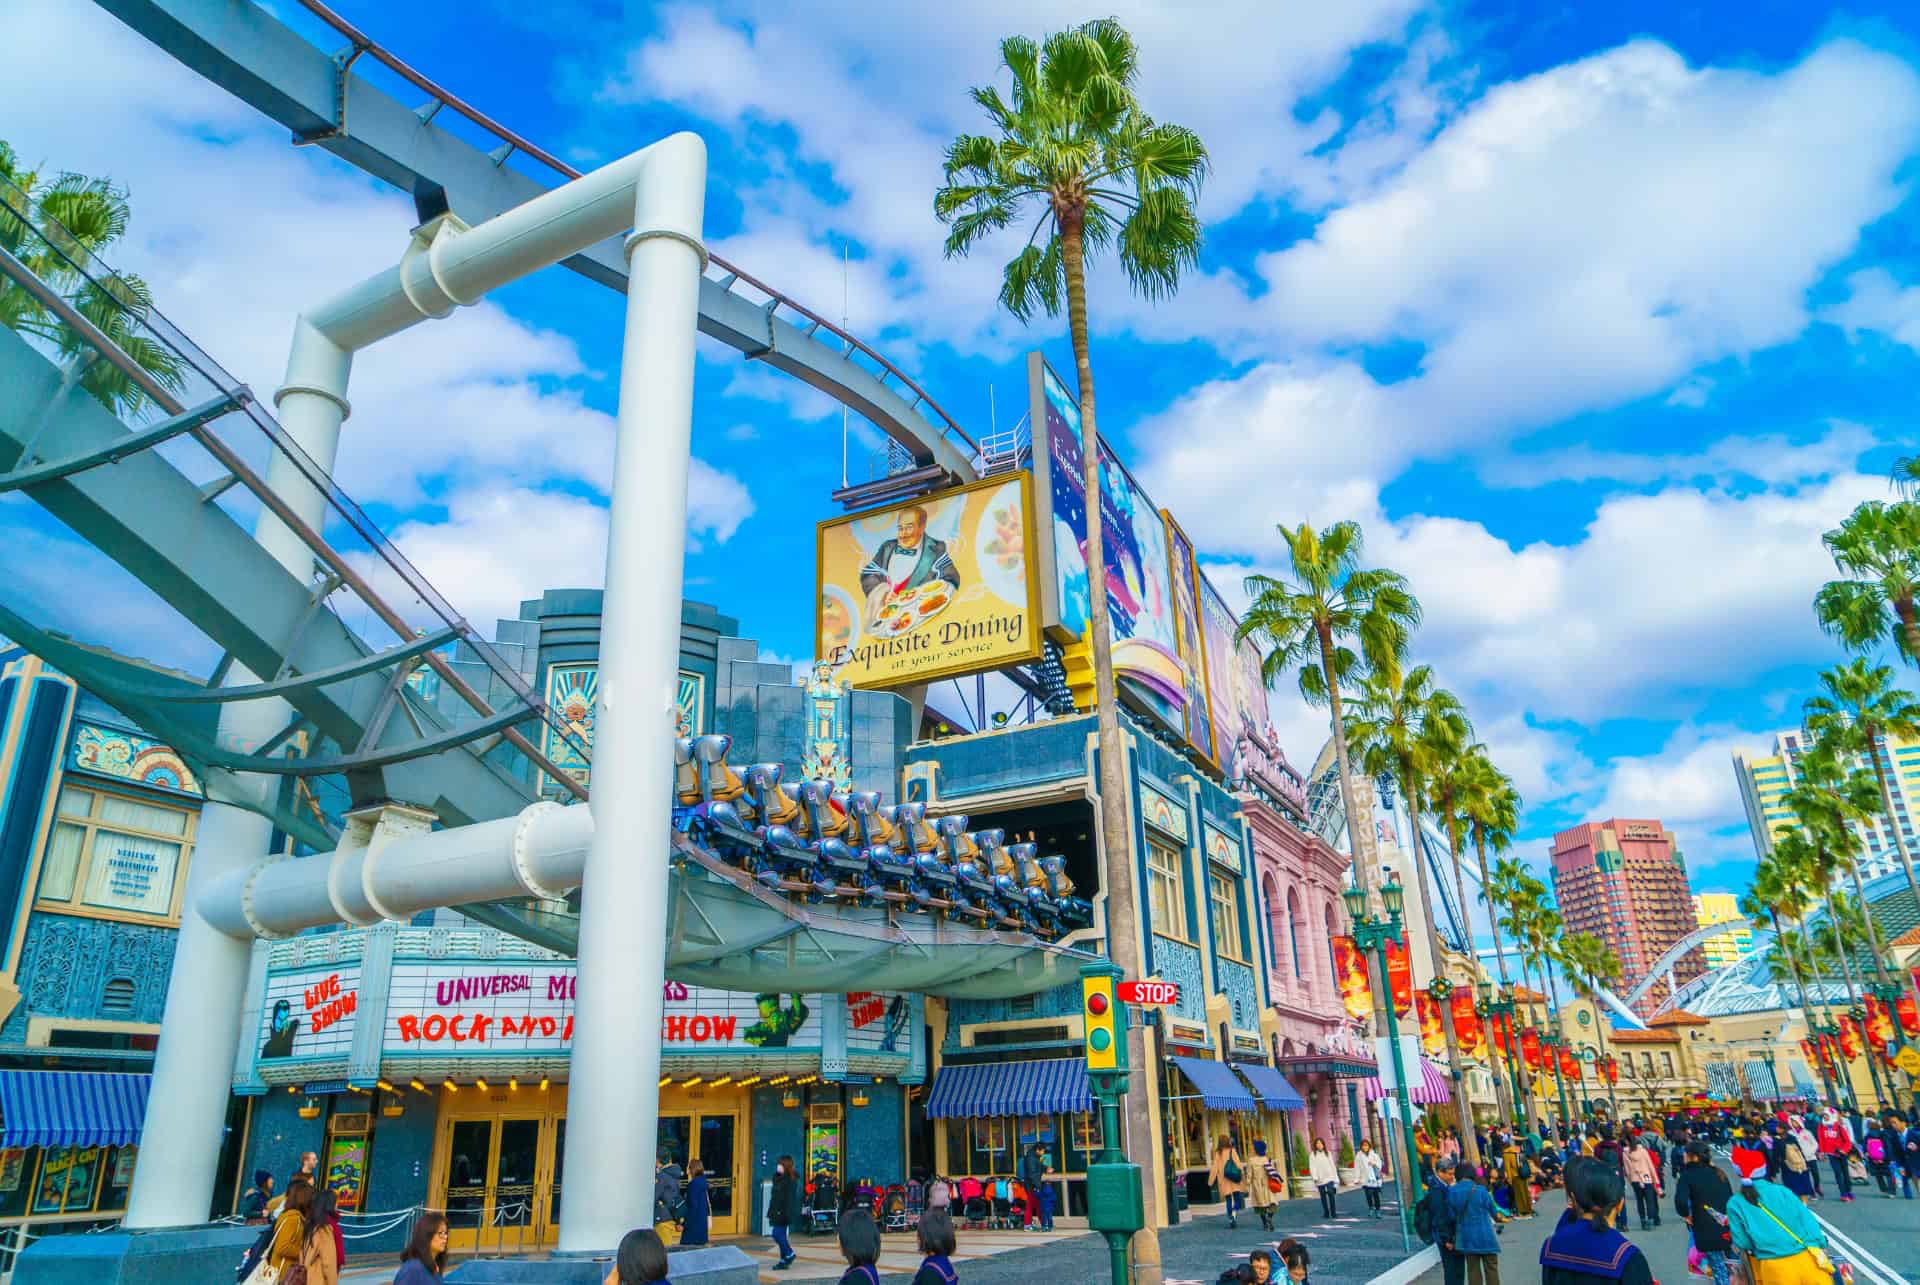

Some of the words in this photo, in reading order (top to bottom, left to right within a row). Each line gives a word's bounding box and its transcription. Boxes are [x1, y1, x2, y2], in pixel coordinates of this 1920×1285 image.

[829, 631, 931, 670] Exquisite
[938, 612, 1023, 645] Dining
[891, 659, 905, 671] at
[911, 653, 941, 667] your
[947, 642, 994, 659] service
[304, 974, 340, 1010] LIVE
[436, 974, 531, 1007] UNIVERSAL
[1135, 983, 1175, 1003] STOP
[311, 991, 357, 1034] SHOW
[397, 1013, 494, 1043] ROCK
[501, 1015, 557, 1038] AND
[662, 1015, 737, 1042] HOW
